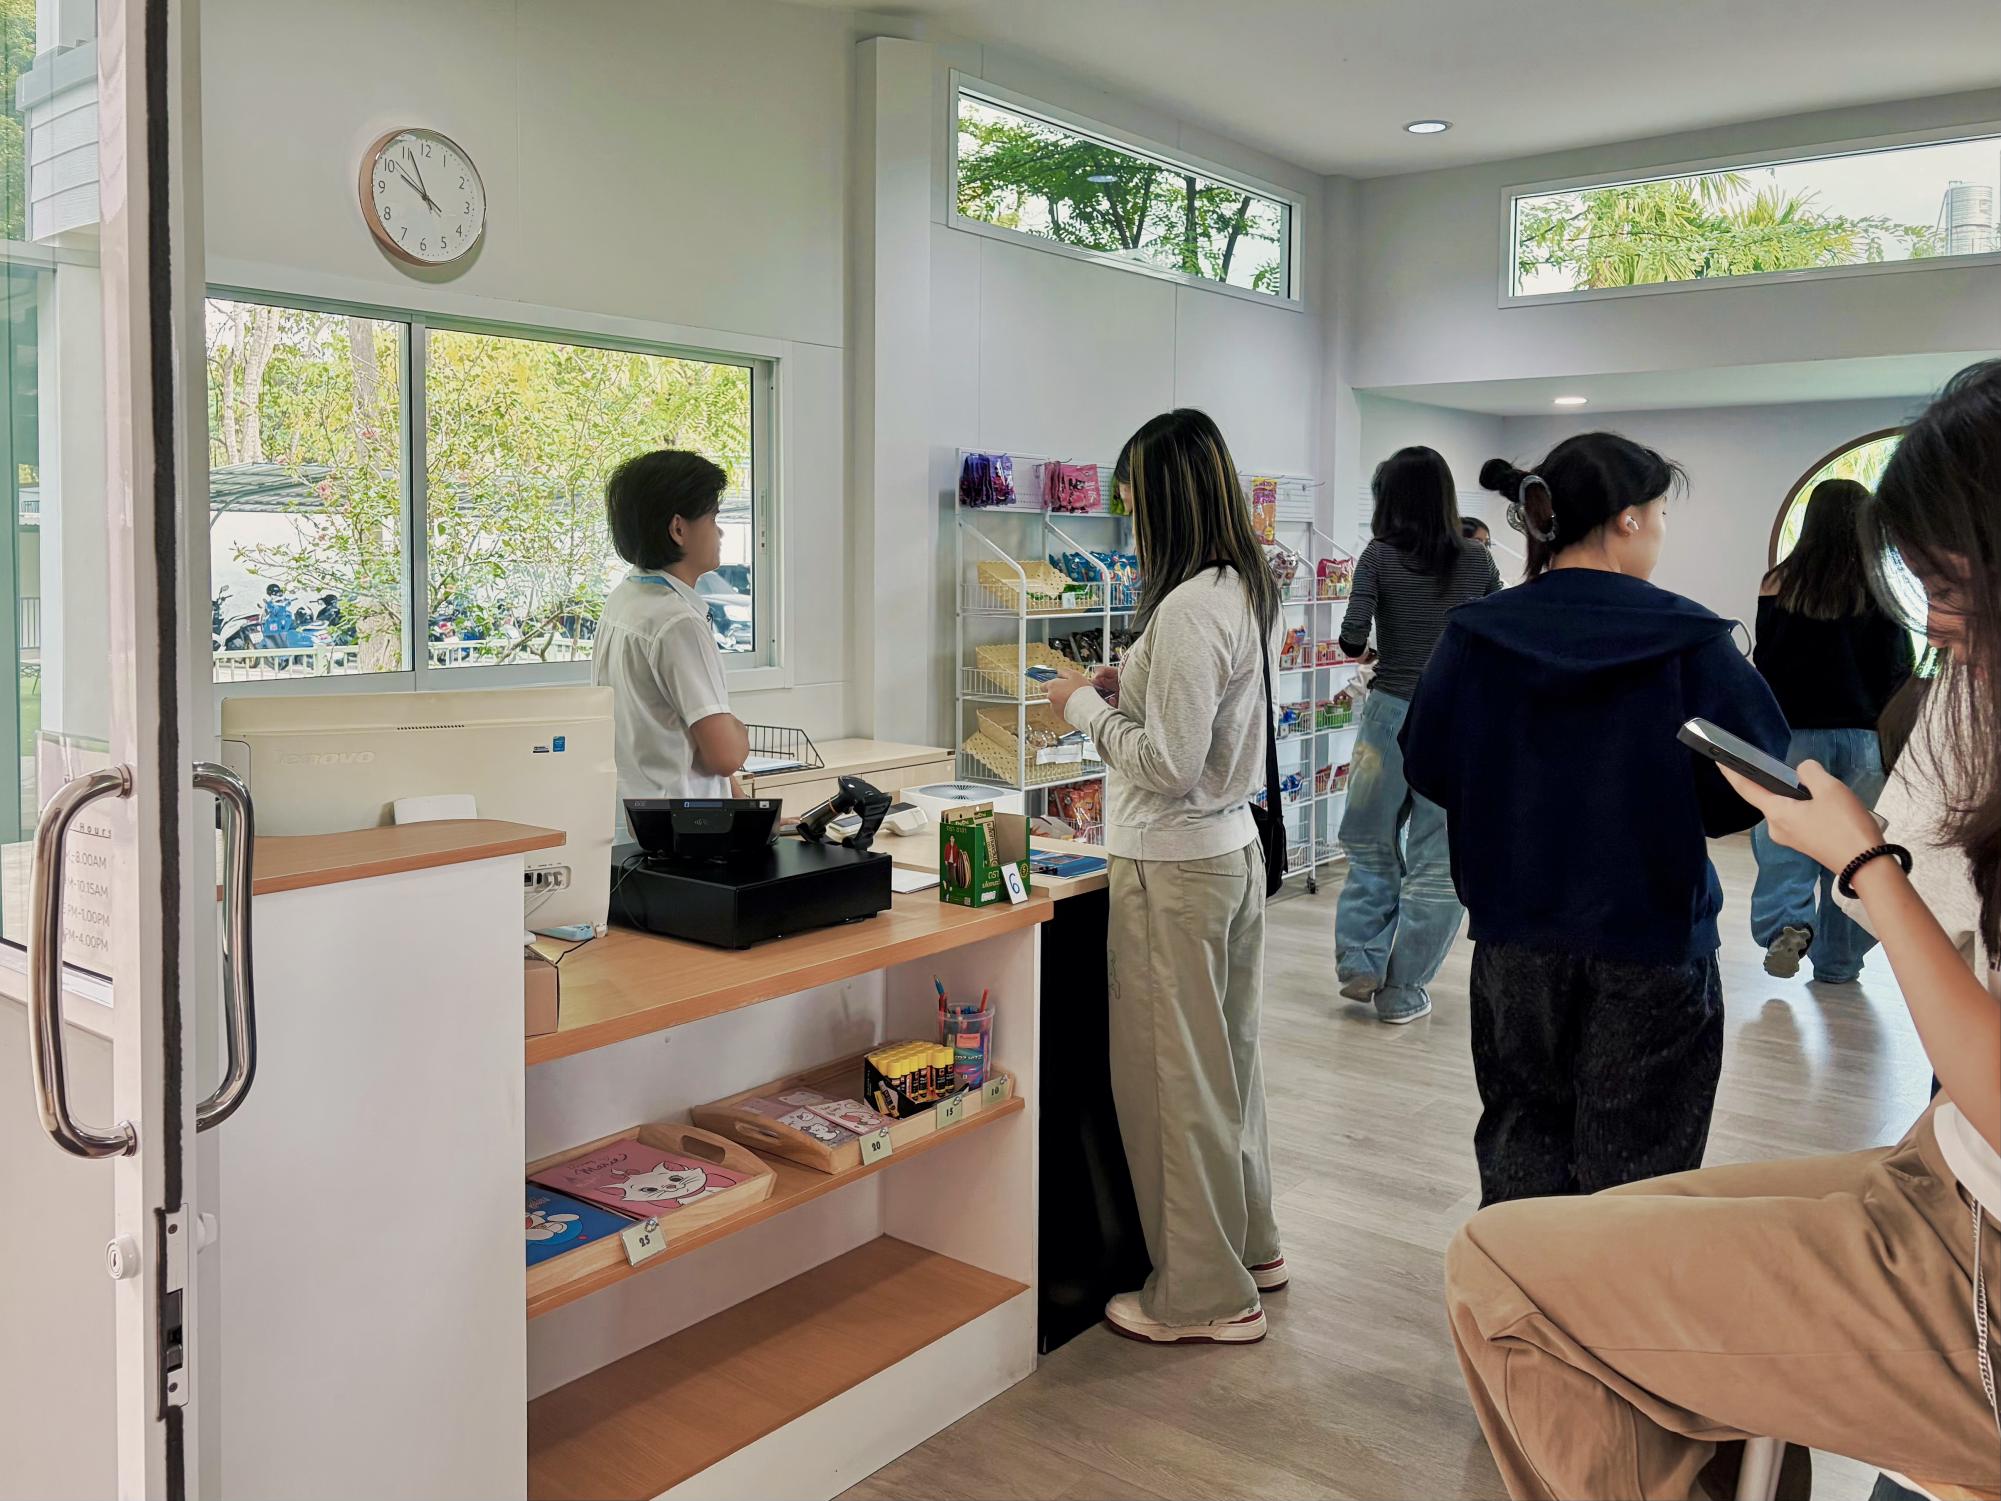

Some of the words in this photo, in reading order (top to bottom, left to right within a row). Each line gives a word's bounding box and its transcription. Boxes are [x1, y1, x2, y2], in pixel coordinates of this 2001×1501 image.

[402, 146, 410, 160] 11
[420, 143, 432, 158] 12
[384, 158, 395, 173] 10
[378, 180, 386, 193] 9
[458, 176, 465, 189] 2
[383, 206, 391, 220] 8
[463, 201, 470, 214] 3
[401, 226, 408, 240] 7
[455, 224, 462, 237] 4
[419, 238, 427, 251] 6
[440, 236, 447, 249] 5
[1009, 873, 1020, 894] 6
[991, 1086, 1000, 1096] 10
[946, 1107, 954, 1117] 15
[871, 1141, 881, 1152] 20
[639, 1235, 650, 1247] 25
